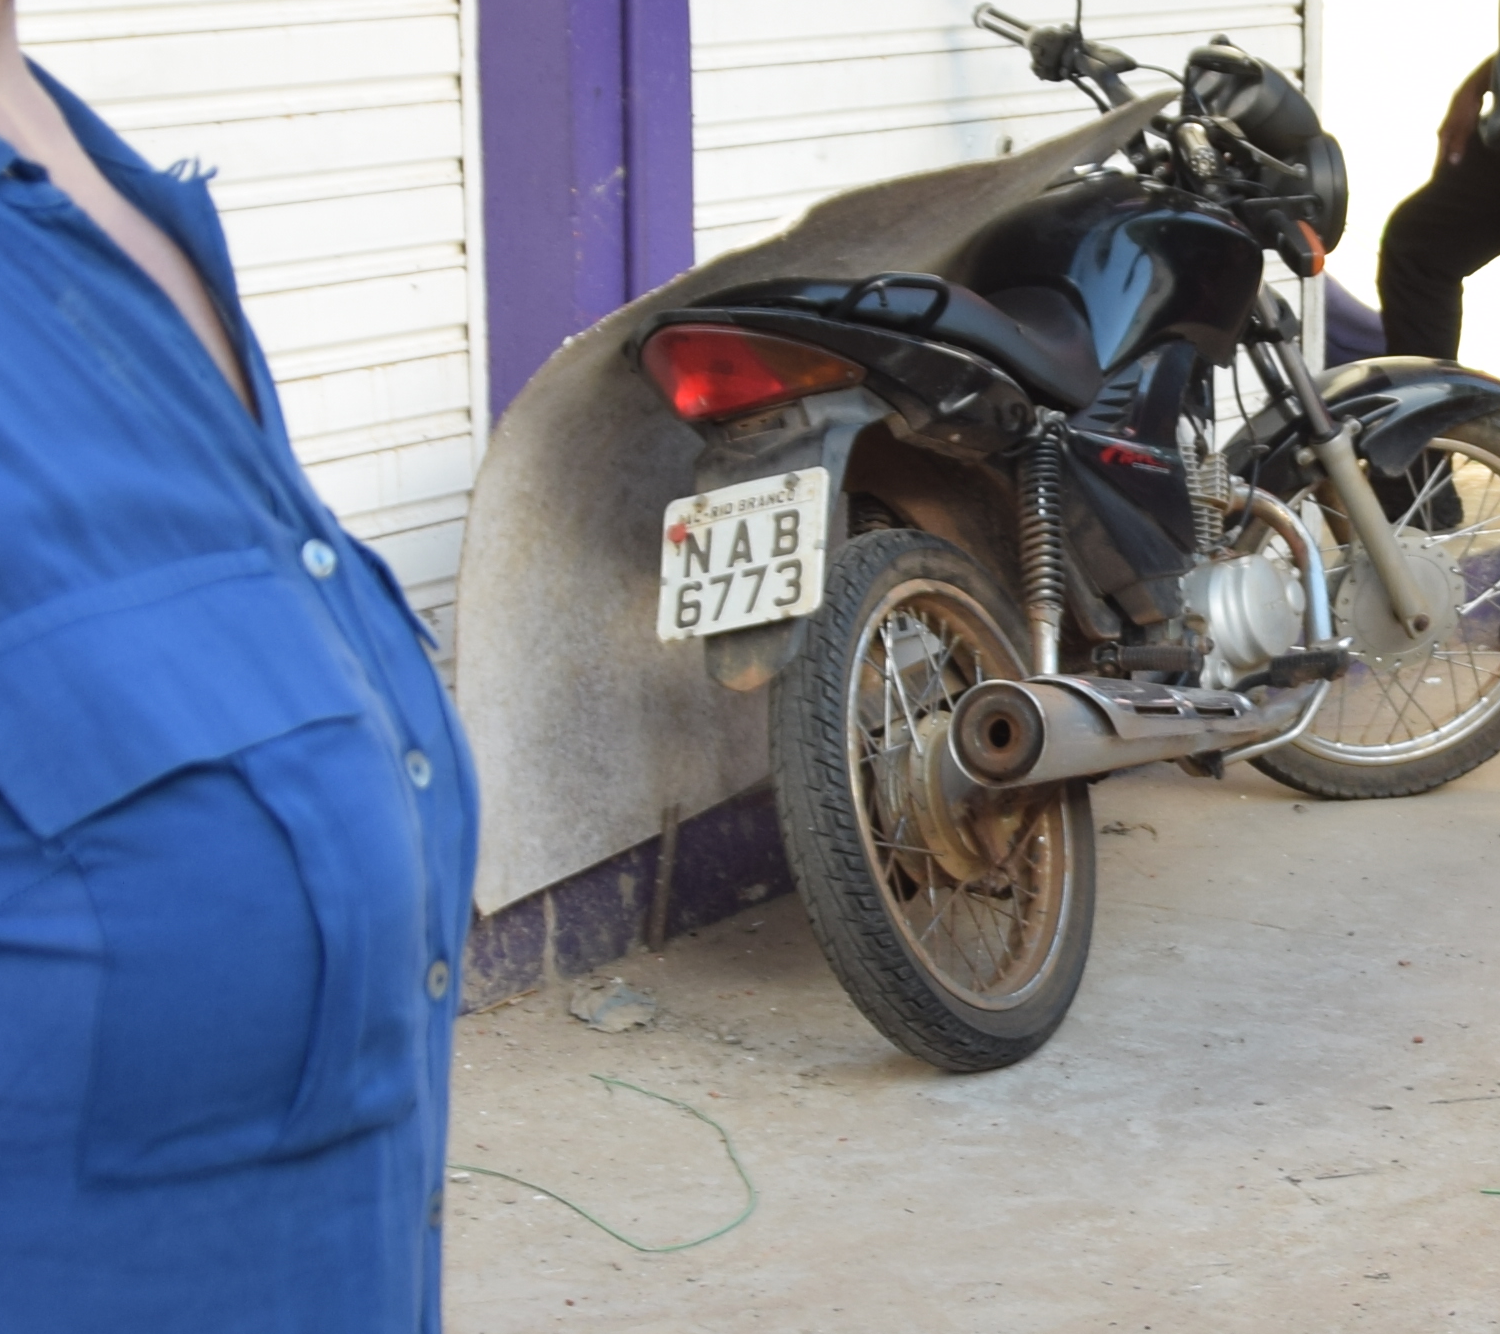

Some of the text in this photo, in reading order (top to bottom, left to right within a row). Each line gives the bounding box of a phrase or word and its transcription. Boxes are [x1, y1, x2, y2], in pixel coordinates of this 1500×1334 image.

[737, 487, 797, 512] BRANCO
[683, 508, 800, 578] NAB
[675, 558, 803, 629] 6773
